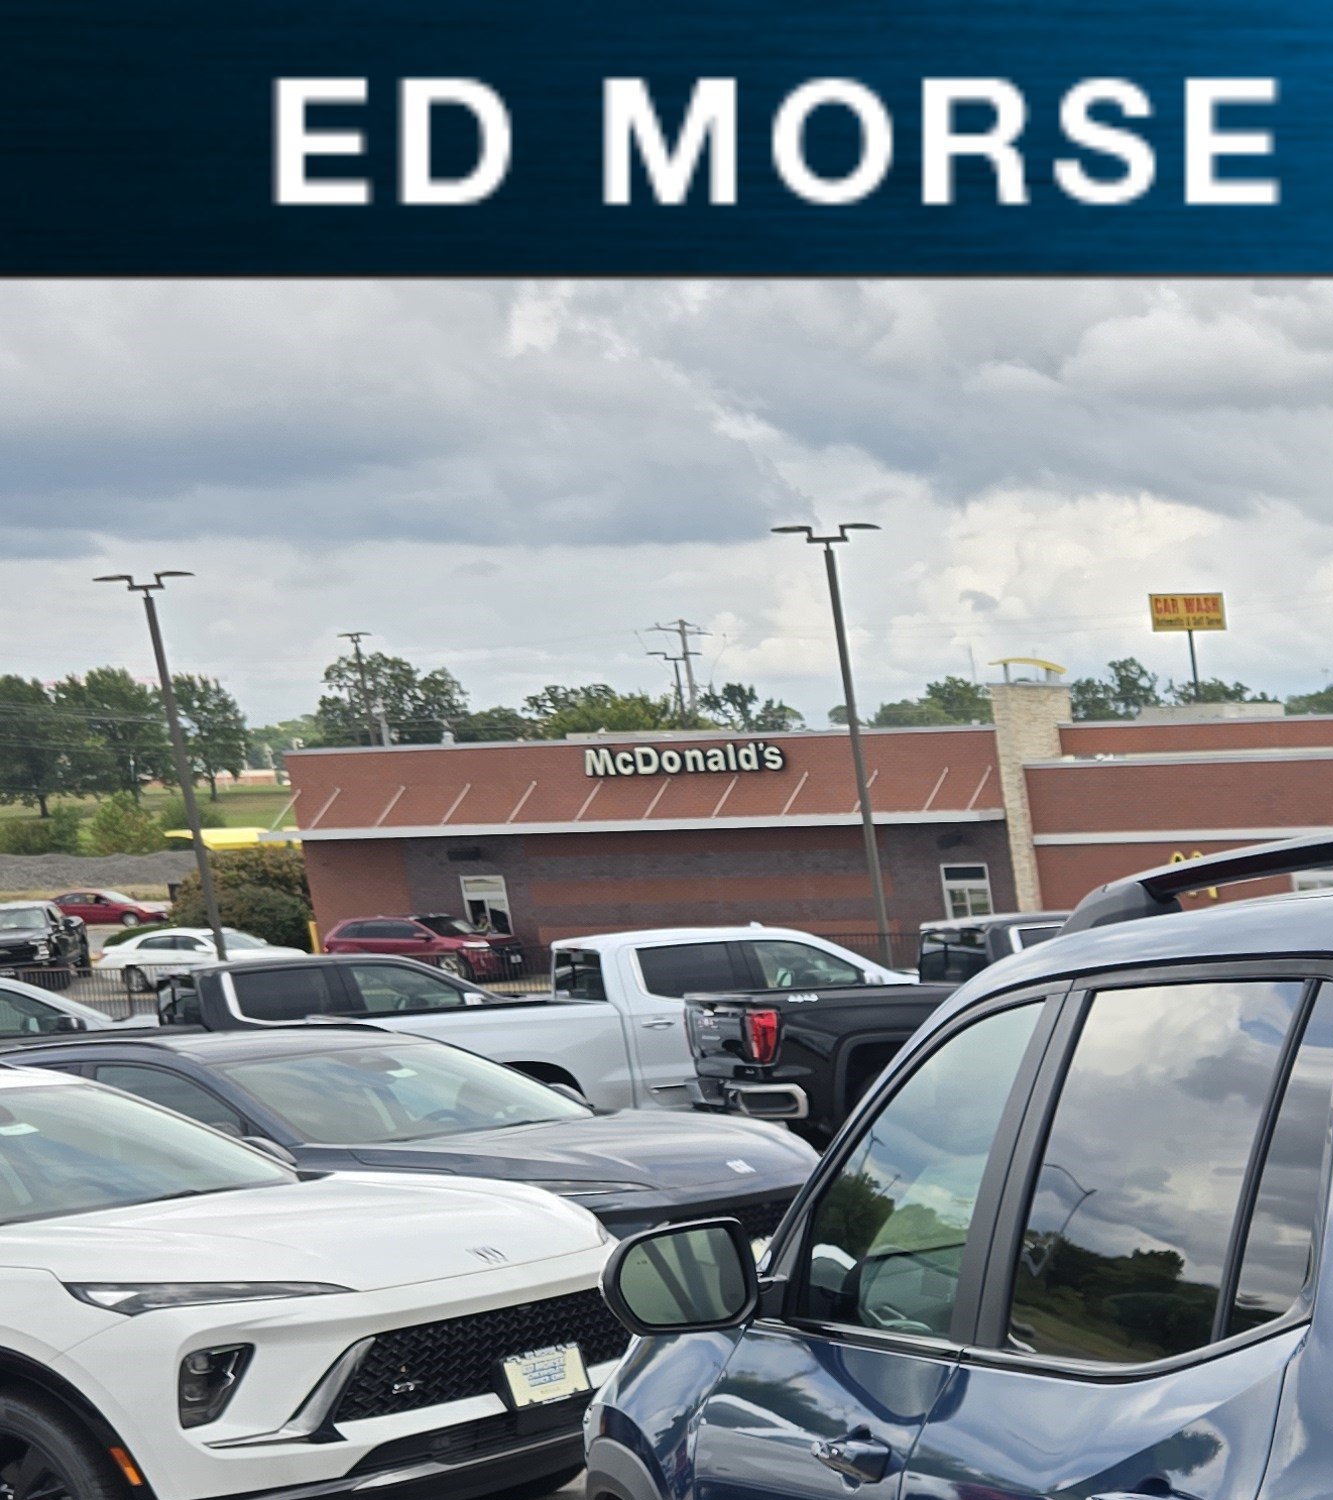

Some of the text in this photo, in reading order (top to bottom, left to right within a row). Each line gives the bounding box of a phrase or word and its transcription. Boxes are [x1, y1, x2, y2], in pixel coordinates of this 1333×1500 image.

[1154, 597, 1219, 614] CAR WASH
[585, 742, 783, 777] McDonald's
